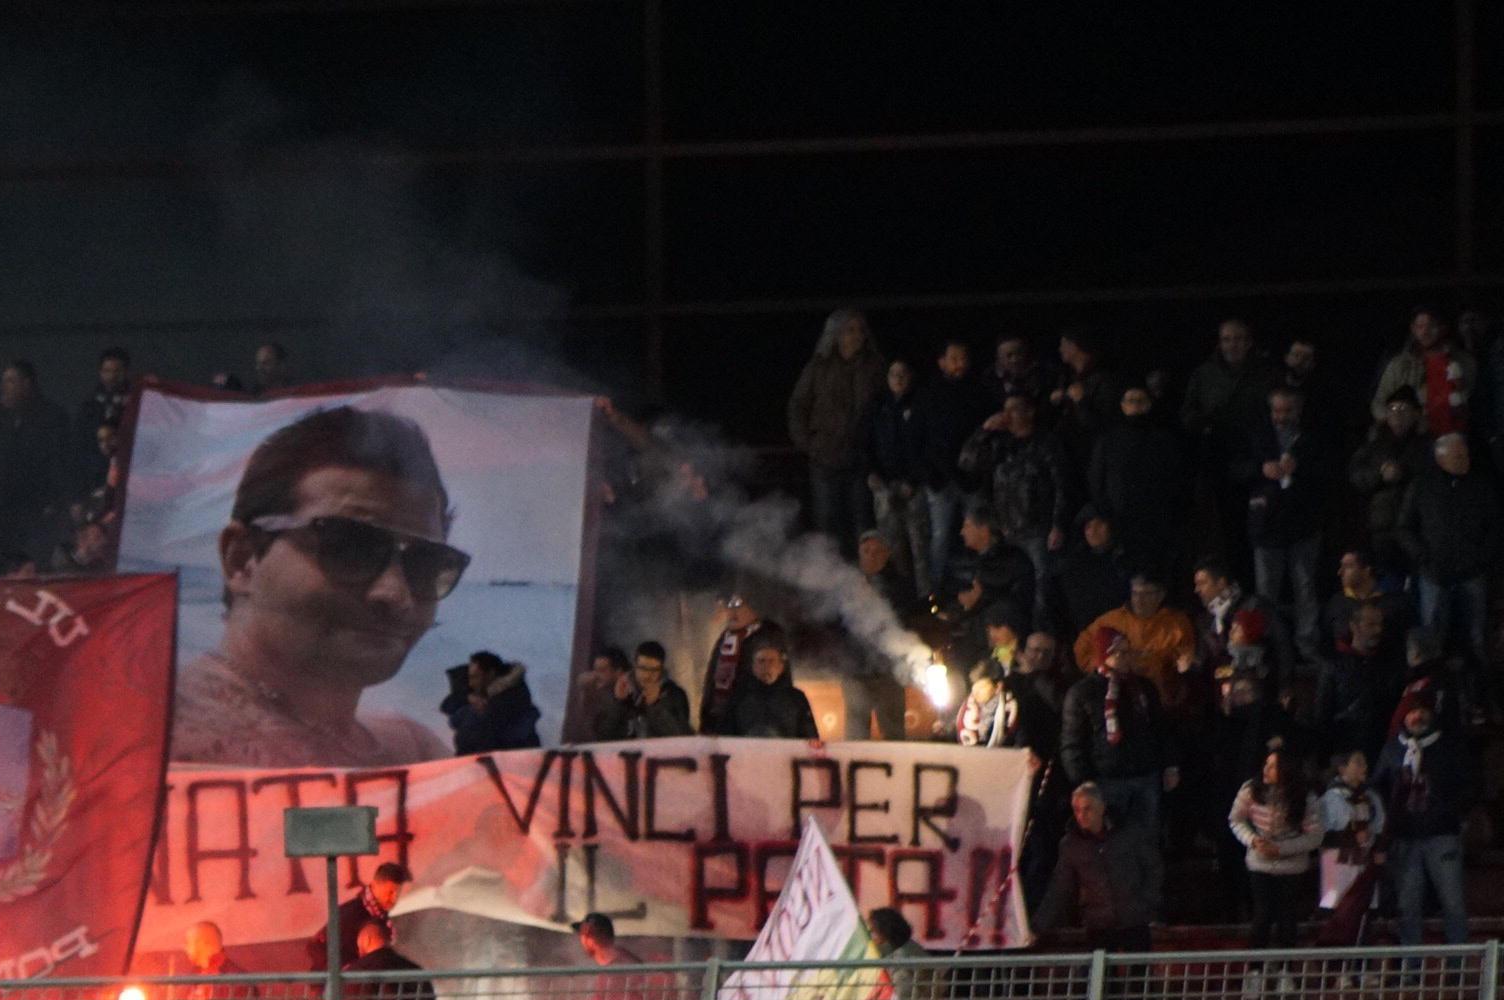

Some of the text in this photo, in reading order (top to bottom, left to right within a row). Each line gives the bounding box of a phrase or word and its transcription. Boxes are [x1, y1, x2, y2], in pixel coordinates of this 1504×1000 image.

[477, 750, 733, 842] VINCI
[790, 757, 960, 851] PER
[552, 842, 647, 923] IL
